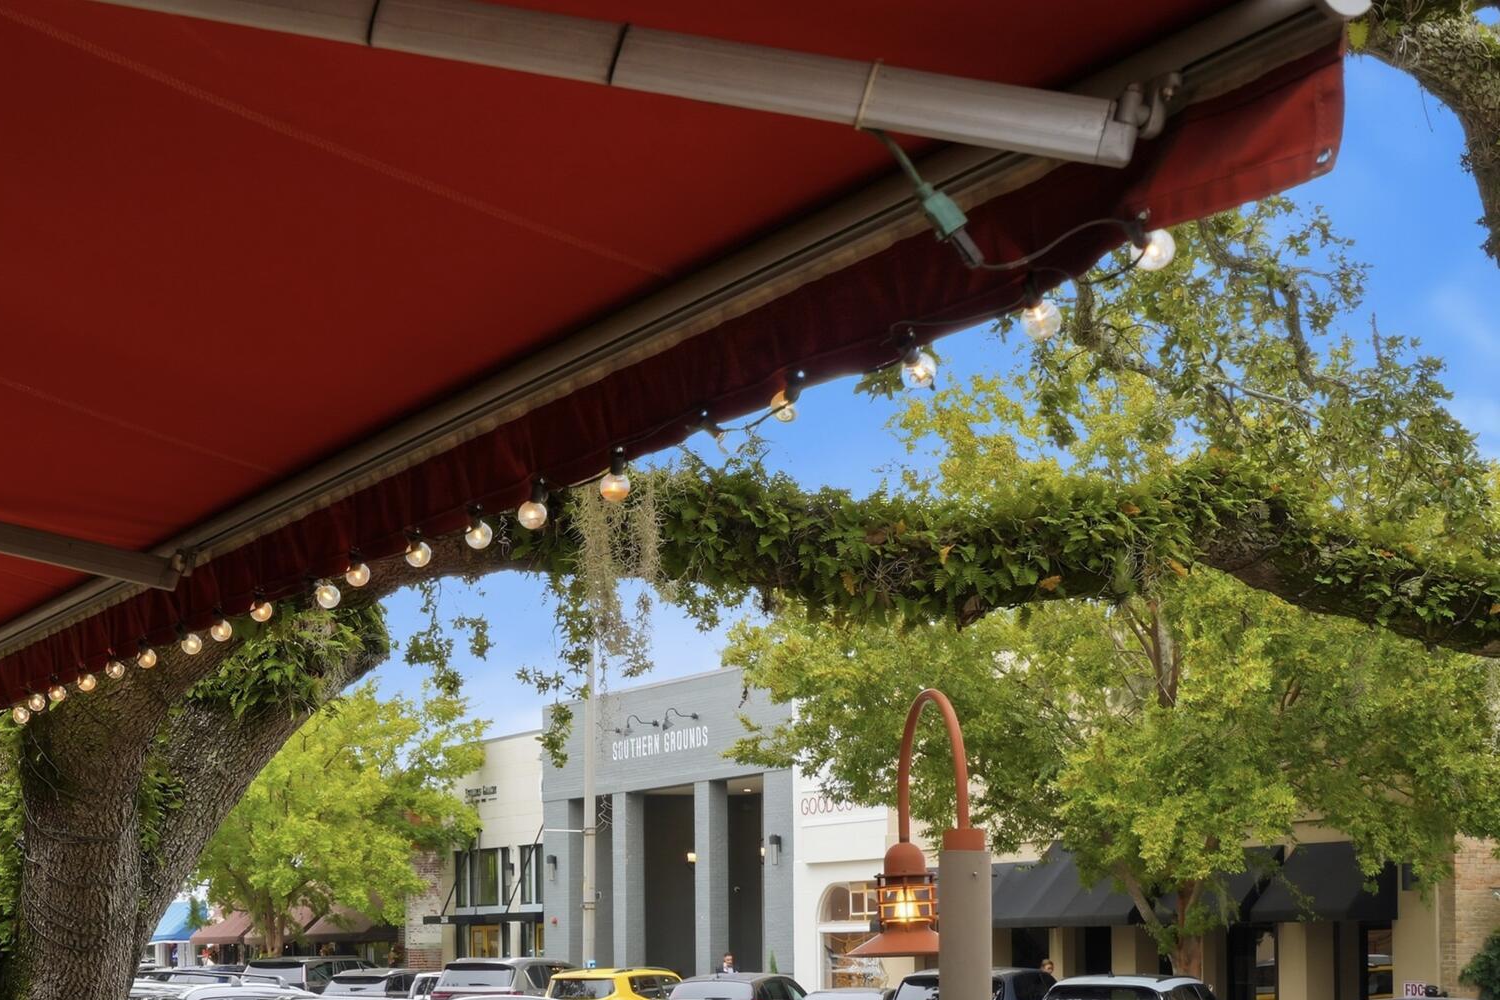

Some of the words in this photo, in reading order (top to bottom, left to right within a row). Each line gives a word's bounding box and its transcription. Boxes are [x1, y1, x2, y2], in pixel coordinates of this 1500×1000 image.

[612, 733, 660, 761] SOUTHERN
[663, 725, 709, 753] GROUNDS
[1405, 983, 1424, 997] FDC
